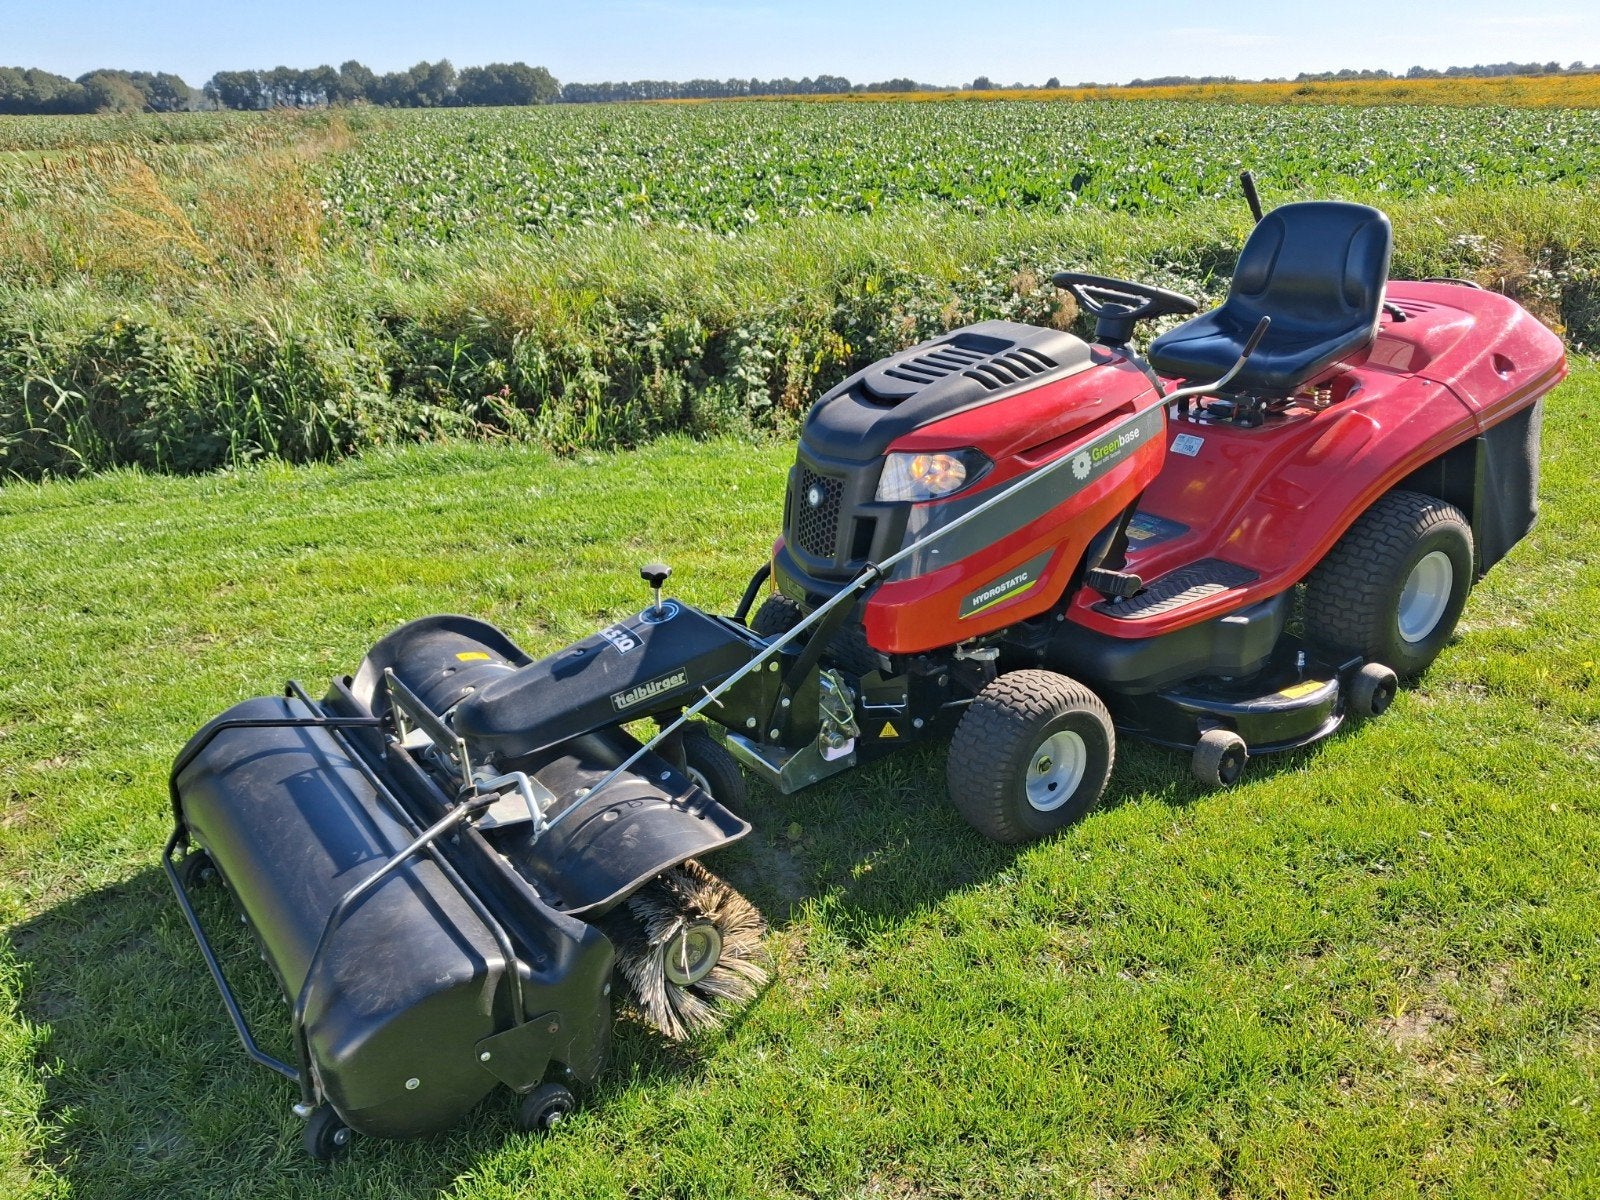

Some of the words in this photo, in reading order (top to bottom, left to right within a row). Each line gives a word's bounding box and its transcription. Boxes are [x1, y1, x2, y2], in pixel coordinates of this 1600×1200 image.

[1091, 427, 1140, 461] Greenbase
[972, 572, 1028, 606] HYDROSTATIC
[613, 672, 686, 709] tielbürger
